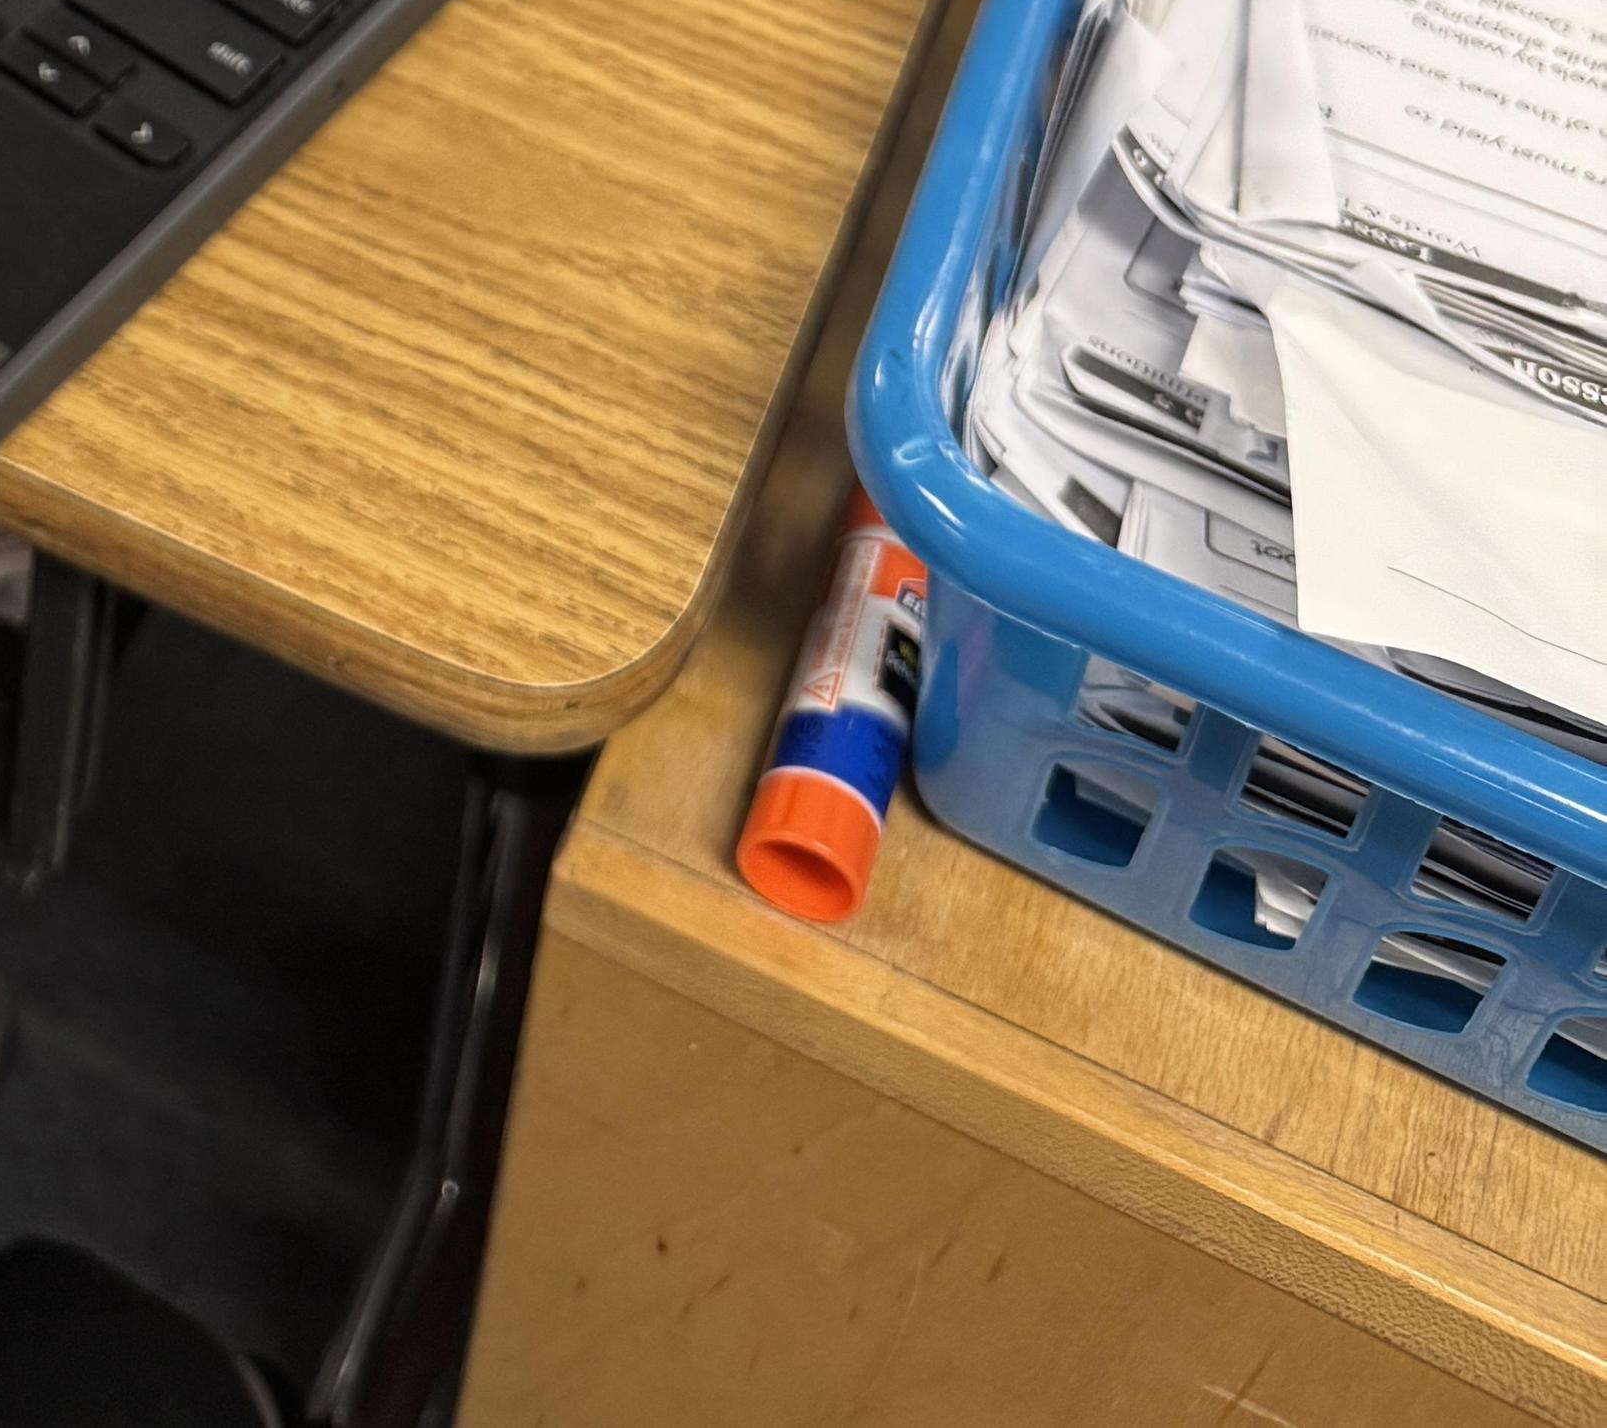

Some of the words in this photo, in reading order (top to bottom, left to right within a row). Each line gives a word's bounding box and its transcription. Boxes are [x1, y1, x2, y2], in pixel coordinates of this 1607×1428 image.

[1400, 58, 1450, 82] and
[1512, 46, 1546, 74] by
[1458, 78, 1509, 106] feet
[1404, 105, 1434, 124] to
[1515, 100, 1560, 124] the
[1440, 119, 1506, 151] yield
[1512, 145, 1578, 178] must
[1383, 215, 1480, 258] Words
